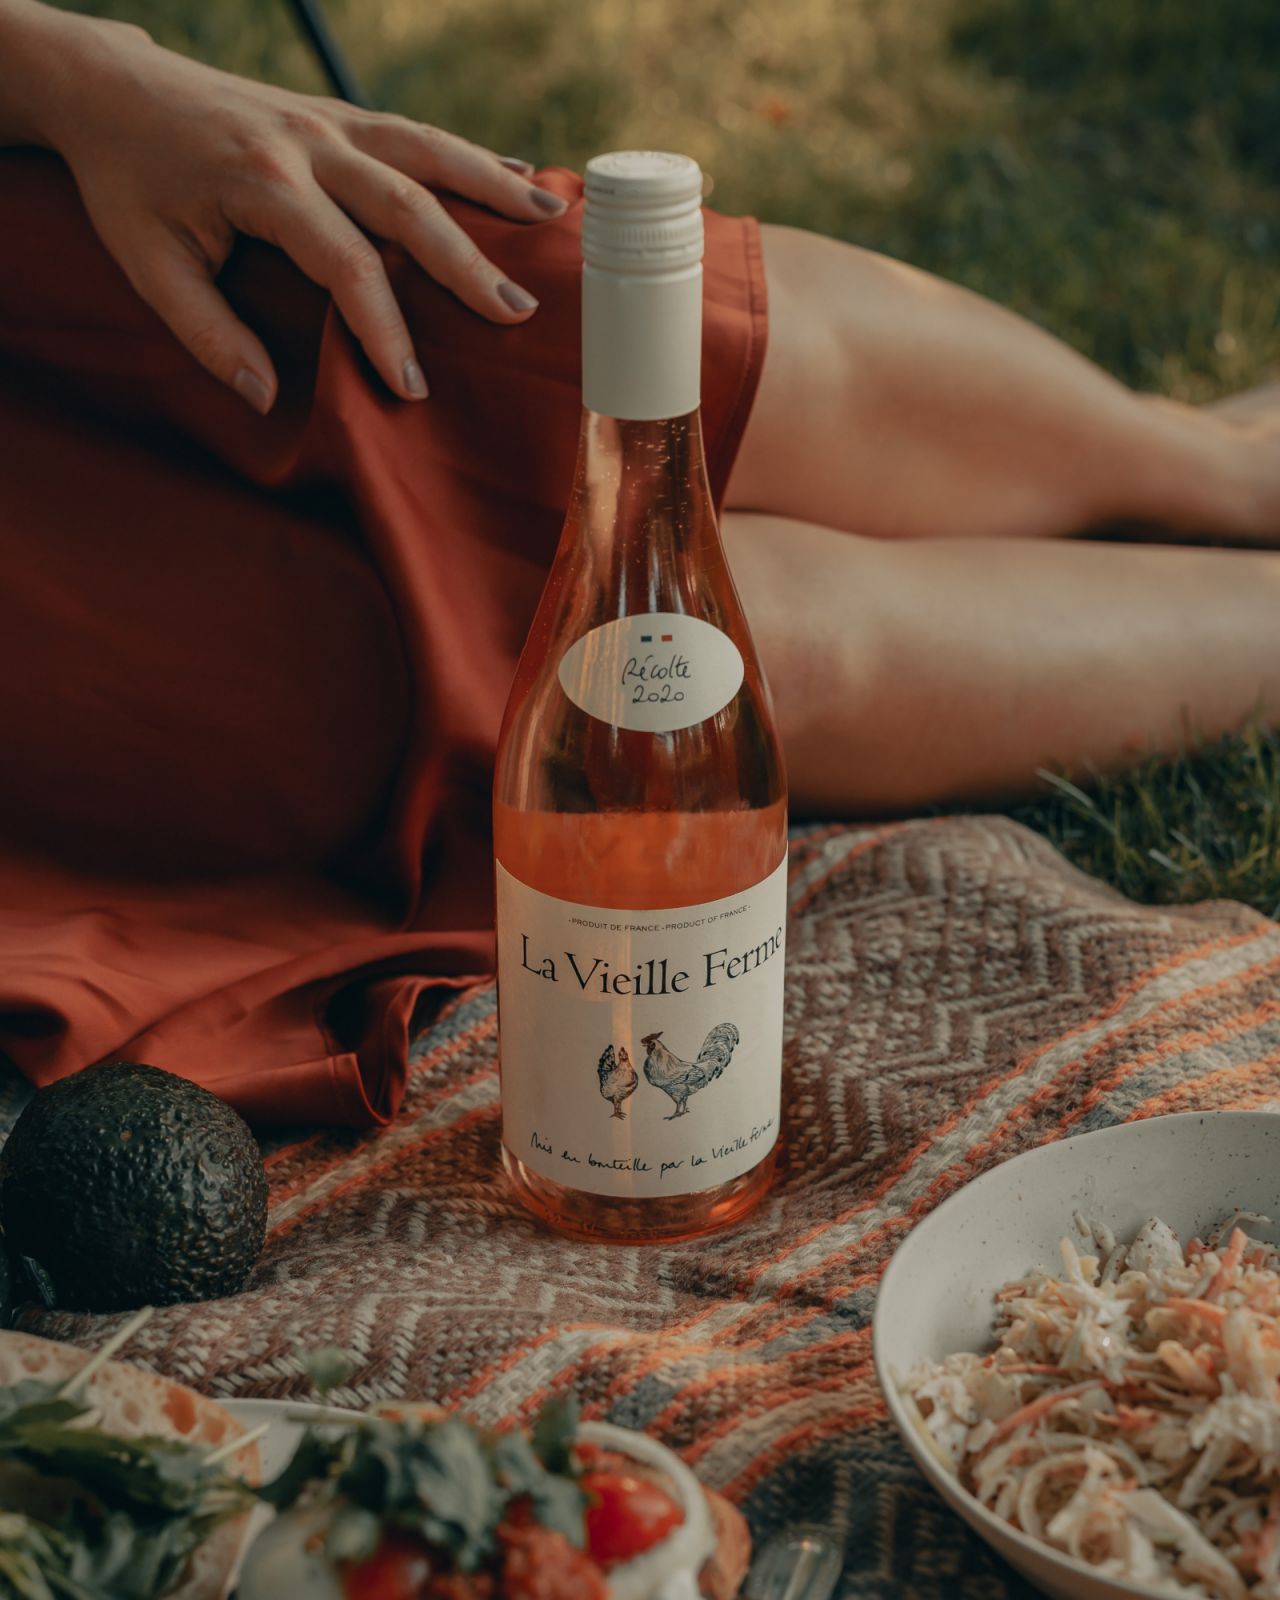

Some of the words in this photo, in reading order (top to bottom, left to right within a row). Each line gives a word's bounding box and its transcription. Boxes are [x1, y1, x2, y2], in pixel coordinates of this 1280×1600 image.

[621, 654, 692, 686] Récolte
[632, 684, 685, 704] 2020
[571, 917, 608, 930] PRODUIT
[610, 923, 622, 932] DE
[624, 924, 660, 932] FRANCE
[665, 918, 706, 931] PRODUCT
[707, 915, 719, 924] OF
[719, 904, 748, 920] FRANCE
[521, 932, 559, 982] La
[564, 950, 690, 996] Vieille
[702, 926, 783, 988] Ferme
[660, 1160, 685, 1179] par
[691, 1155, 707, 1167] la
